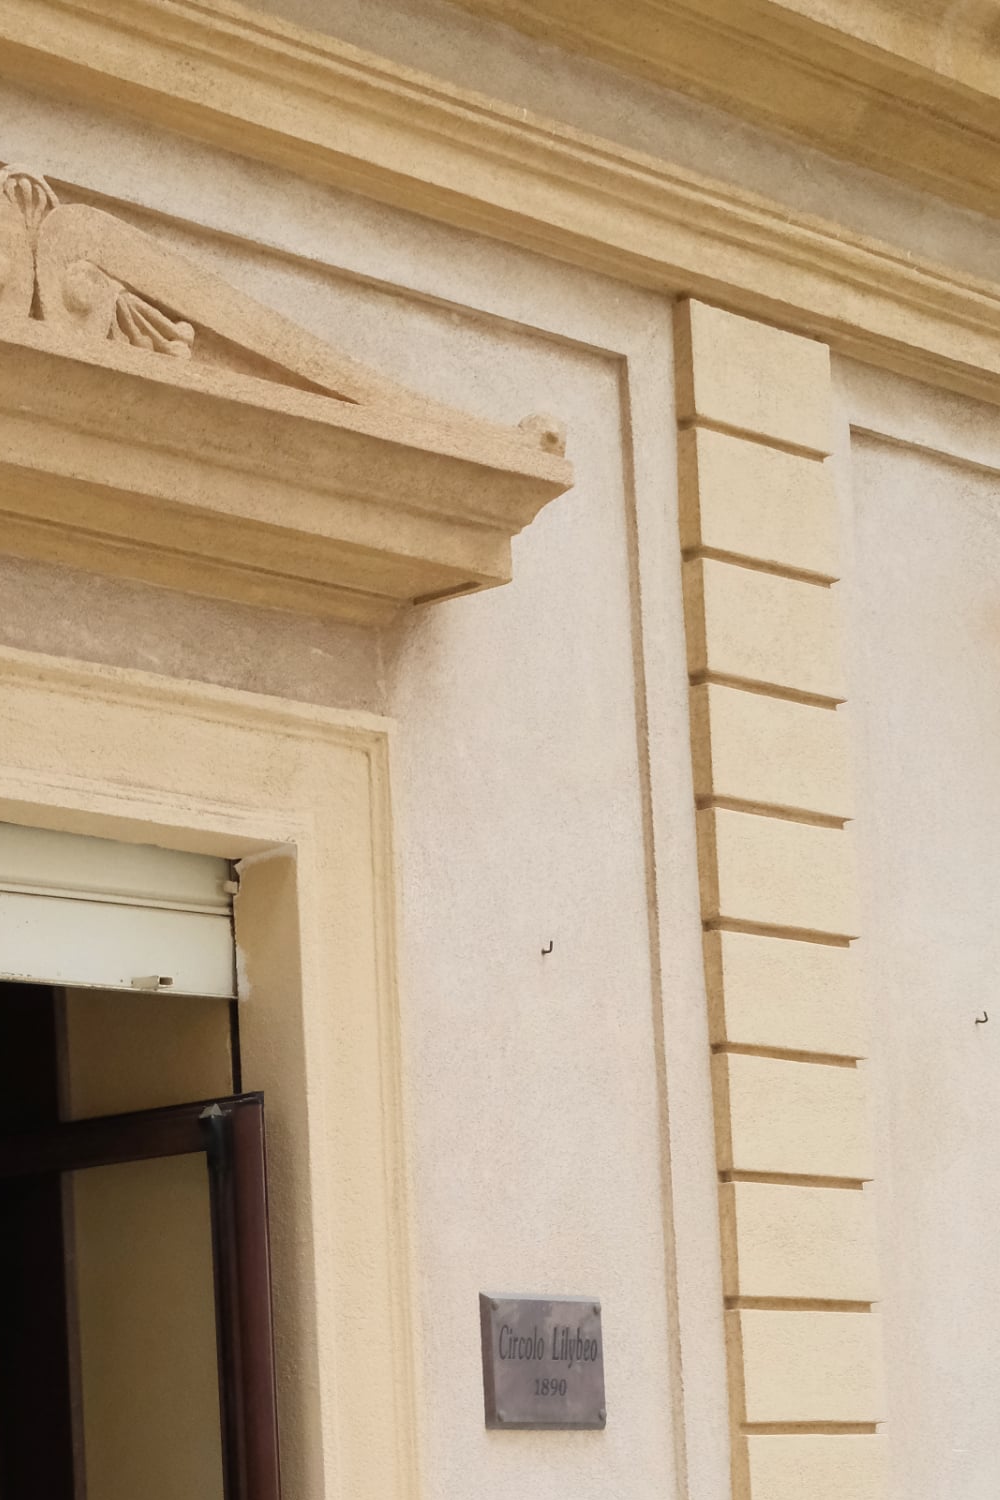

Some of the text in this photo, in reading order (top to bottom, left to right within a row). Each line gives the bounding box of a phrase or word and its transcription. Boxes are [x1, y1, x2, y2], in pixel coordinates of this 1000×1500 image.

[499, 1324, 598, 1369] Circolo Lilybeo
[534, 1378, 567, 1396] 1890
